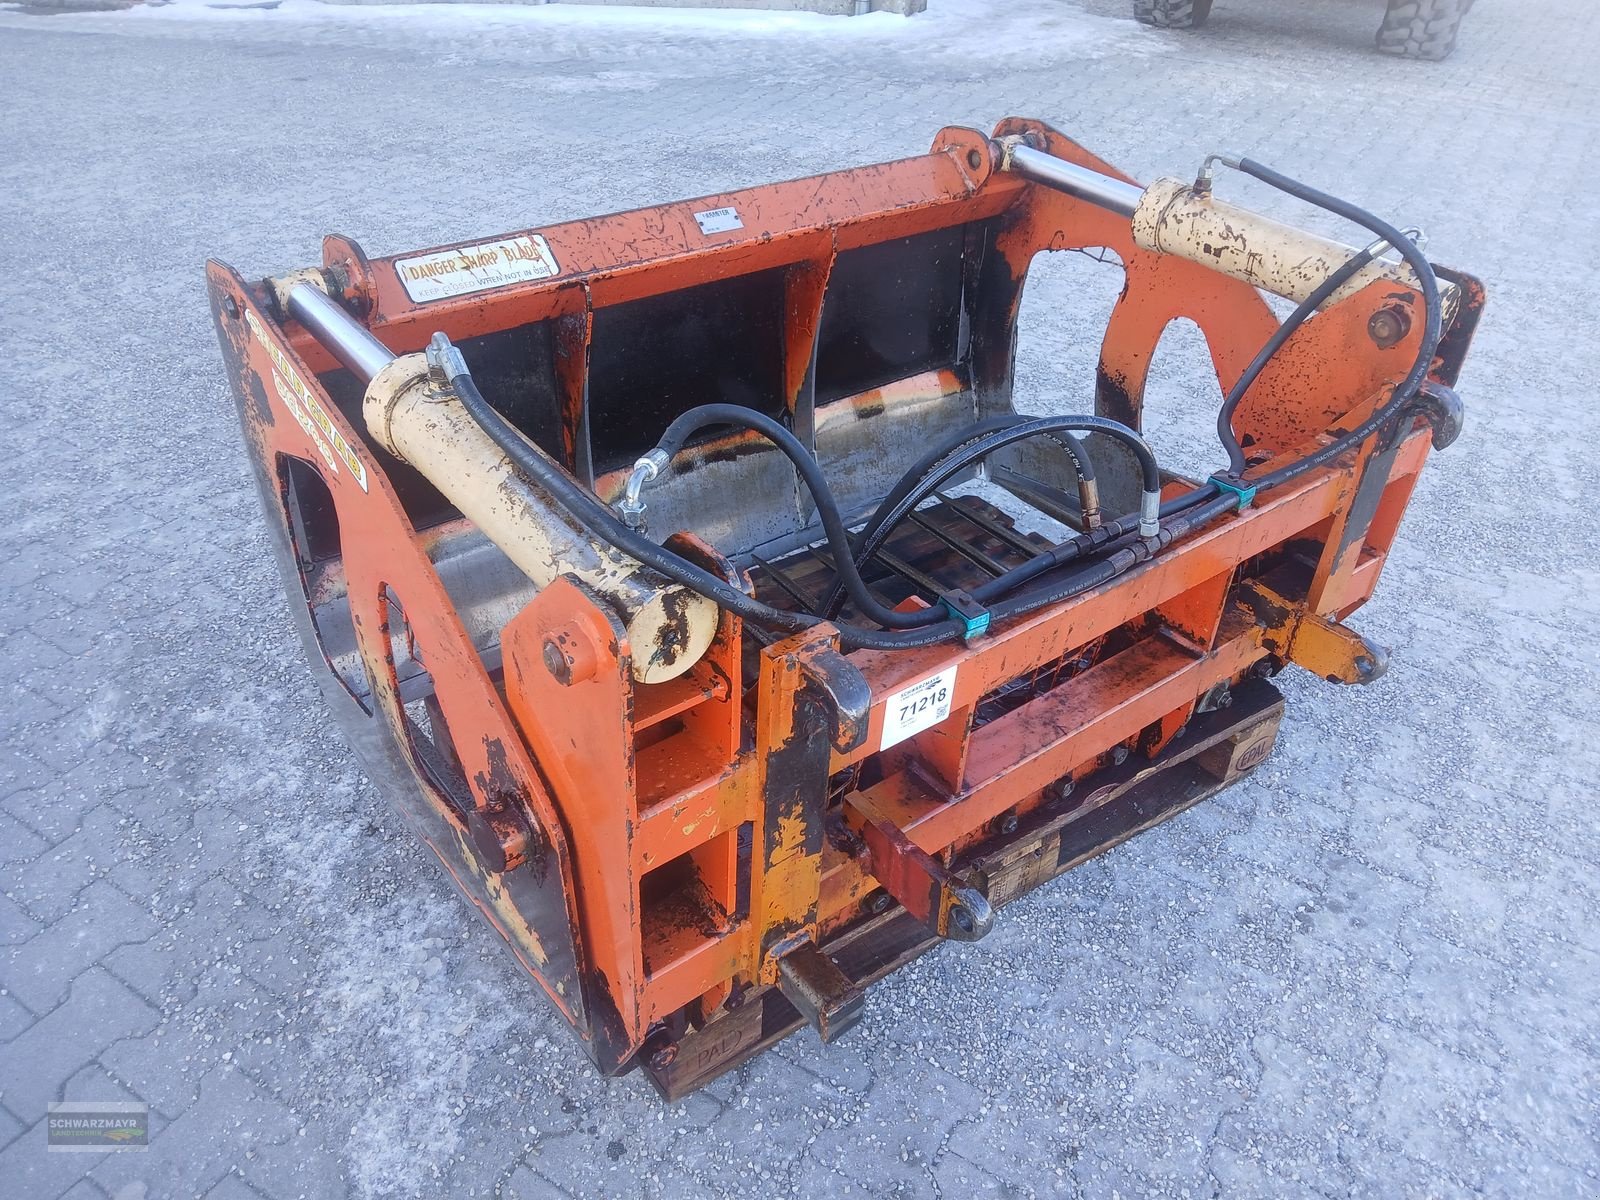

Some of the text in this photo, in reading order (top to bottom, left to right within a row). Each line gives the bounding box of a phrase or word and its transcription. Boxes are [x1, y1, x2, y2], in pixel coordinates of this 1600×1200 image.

[408, 259, 458, 280] DANGER
[460, 251, 498, 270] SHARP
[419, 287, 440, 297] KEEP
[478, 275, 502, 286] WHEN
[504, 271, 521, 280] NOT
[670, 562, 704, 583] manuli
[900, 687, 947, 721] 71218
